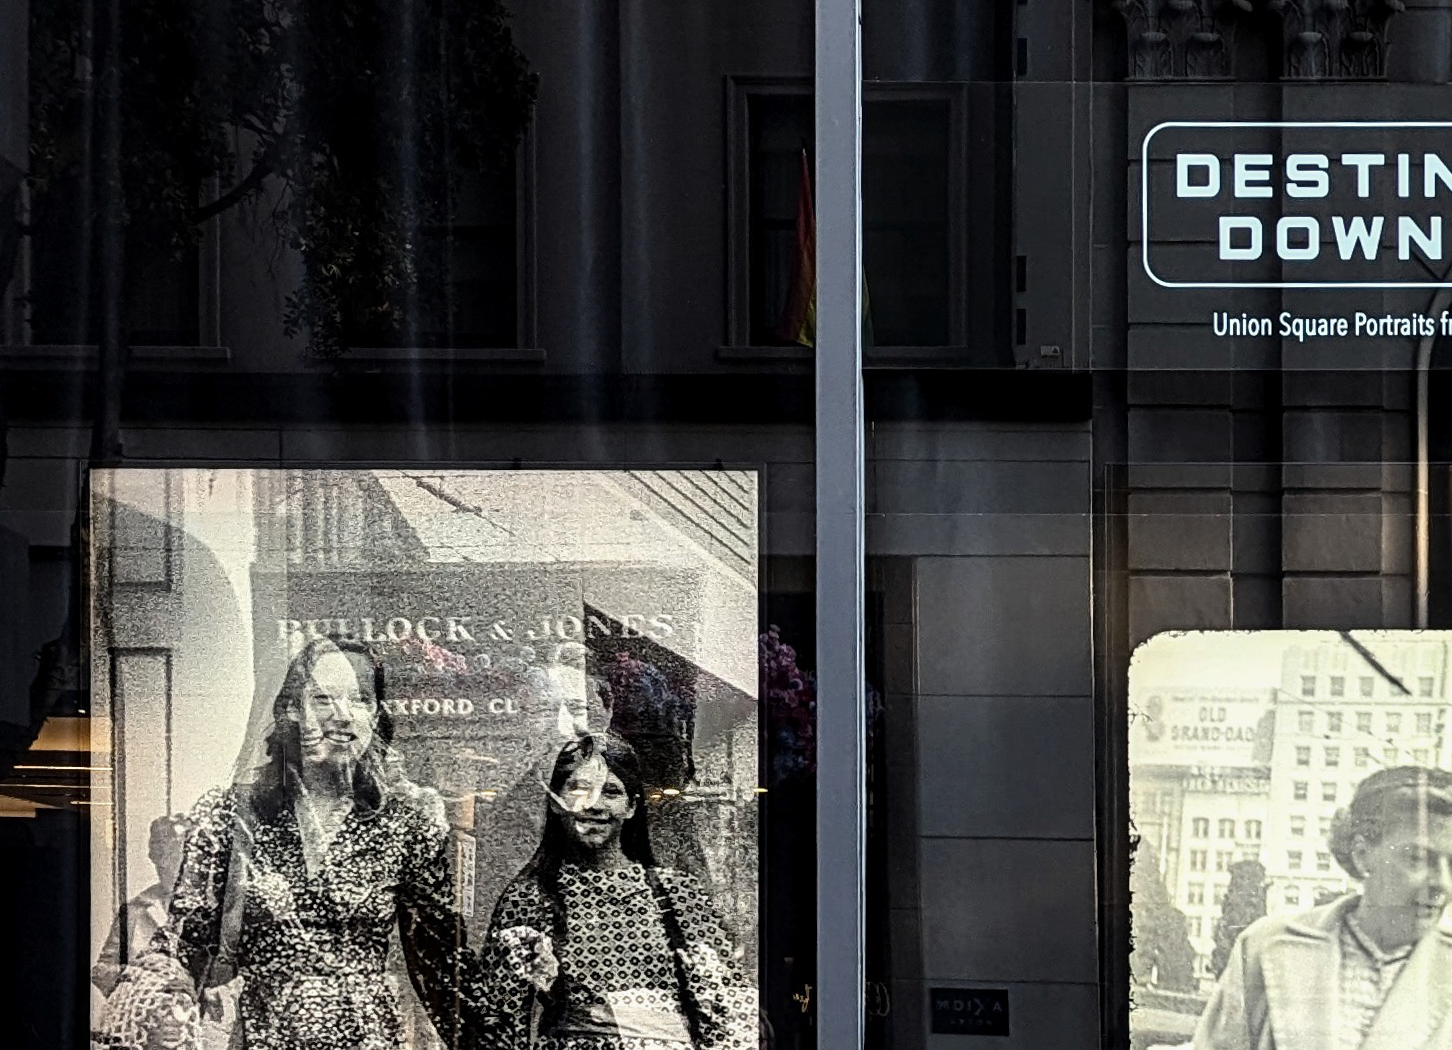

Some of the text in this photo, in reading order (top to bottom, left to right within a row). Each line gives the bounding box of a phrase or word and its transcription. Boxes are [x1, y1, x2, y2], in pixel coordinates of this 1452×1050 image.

[1212, 311, 1273, 337] Union
[1278, 311, 1349, 343] Square
[1354, 311, 1435, 337] Portraits
[526, 614, 674, 639] JONES
[1199, 706, 1227, 723] OLD
